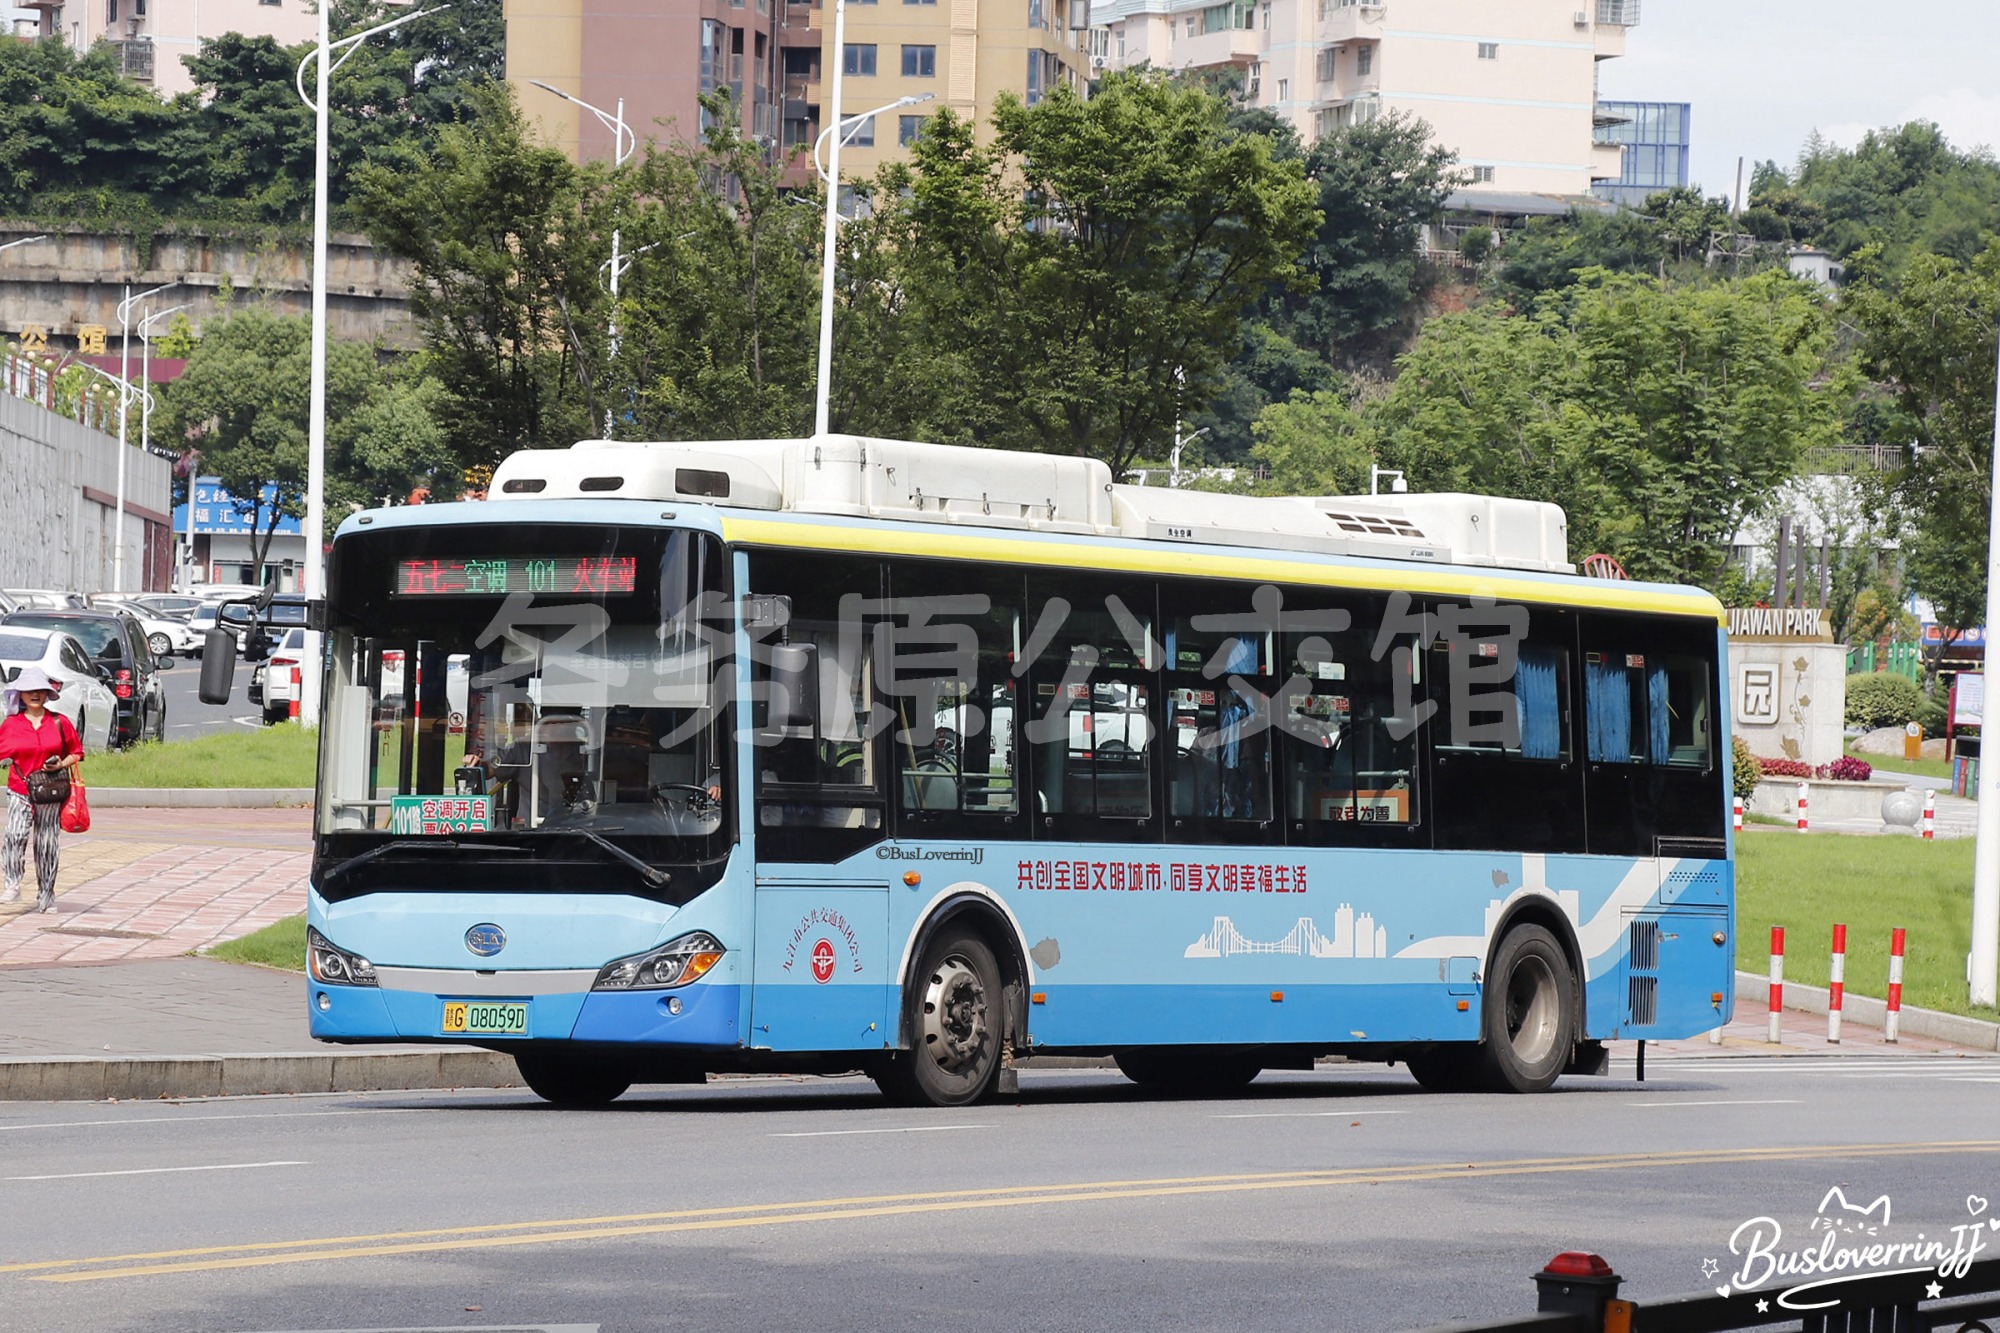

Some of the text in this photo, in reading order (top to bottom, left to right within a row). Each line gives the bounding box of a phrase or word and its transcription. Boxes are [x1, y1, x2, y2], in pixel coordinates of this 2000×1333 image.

[464, 559, 507, 593] 空调
[525, 560, 556, 591] 101
[573, 557, 636, 592] 火车站
[1724, 608, 1822, 636] JIAWAN PARK
[422, 800, 486, 820] 空调开启
